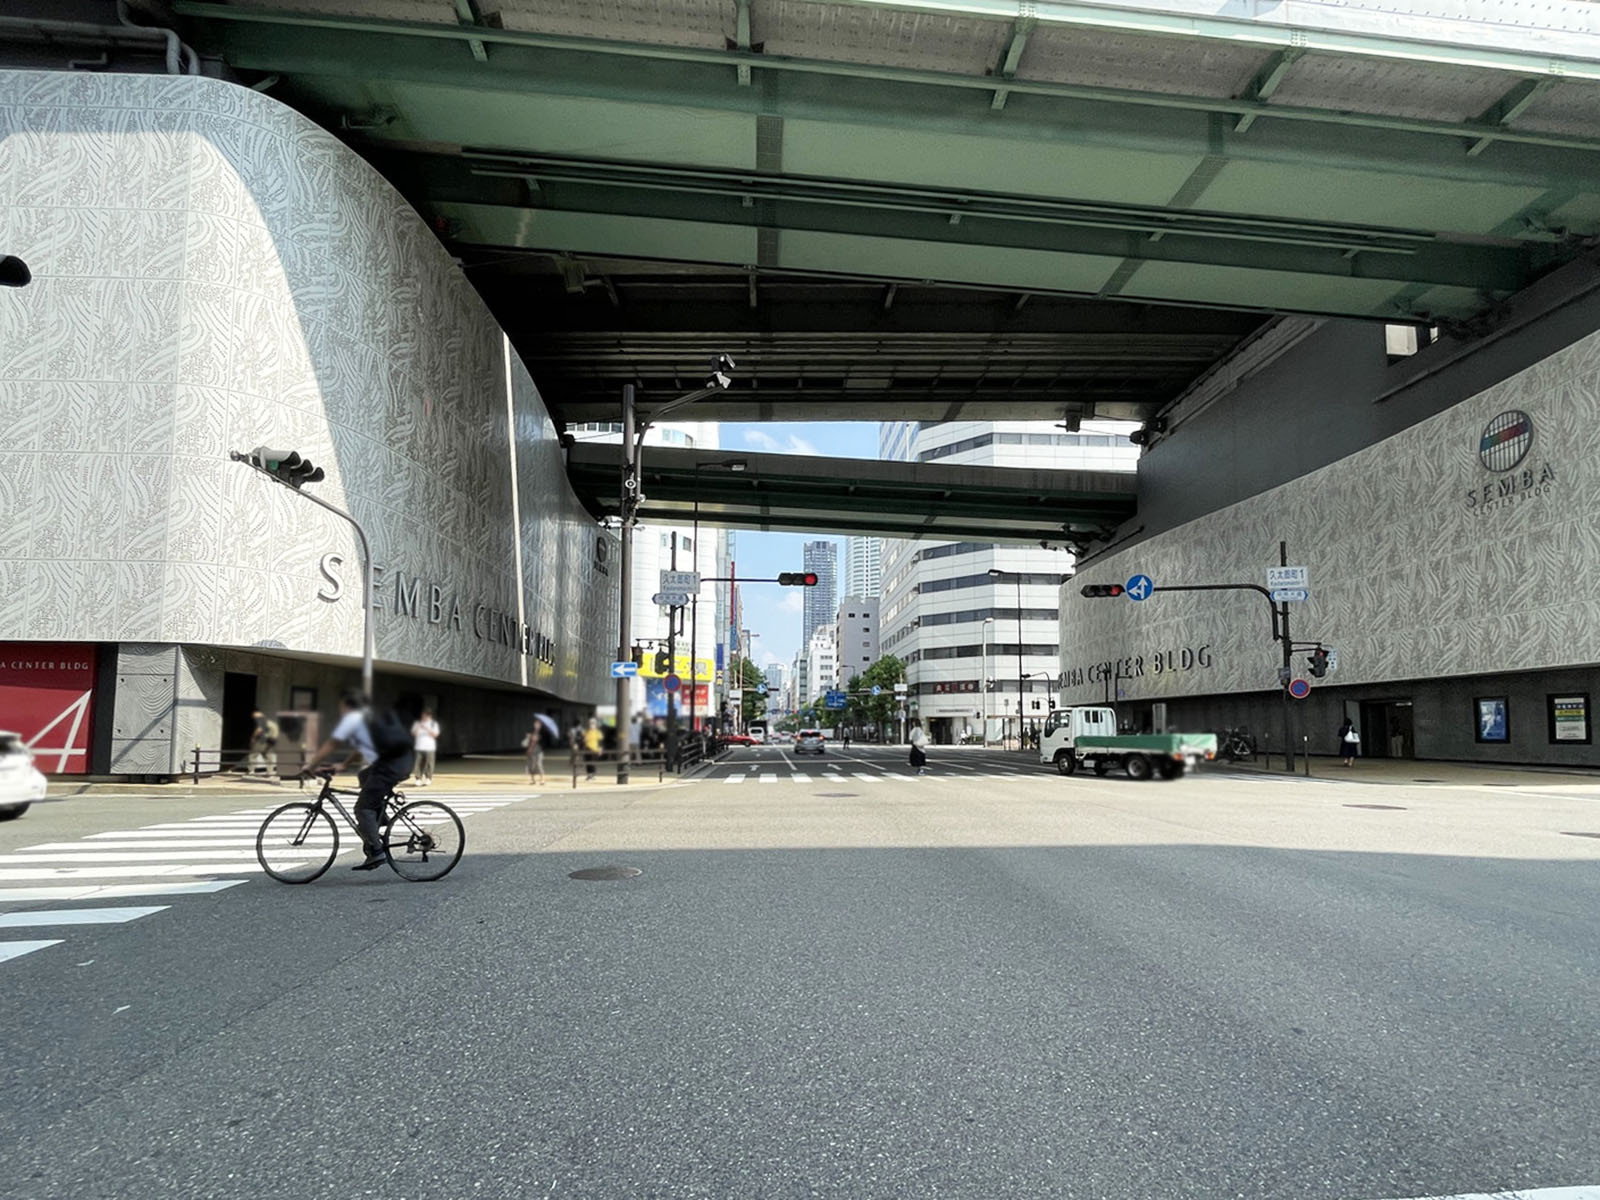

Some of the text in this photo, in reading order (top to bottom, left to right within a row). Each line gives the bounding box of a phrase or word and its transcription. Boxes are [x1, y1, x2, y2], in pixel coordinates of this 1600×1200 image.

[1466, 463, 1555, 508] SEMBA
[1473, 484, 1551, 517] CENTER BLDG
[317, 553, 462, 632] SEMBA
[11, 661, 55, 670] CENTER
[60, 661, 89, 670] BLDG
[1088, 655, 1144, 684] CENTER
[1153, 644, 1212, 675] BLDG
[26, 687, 93, 774] 4
